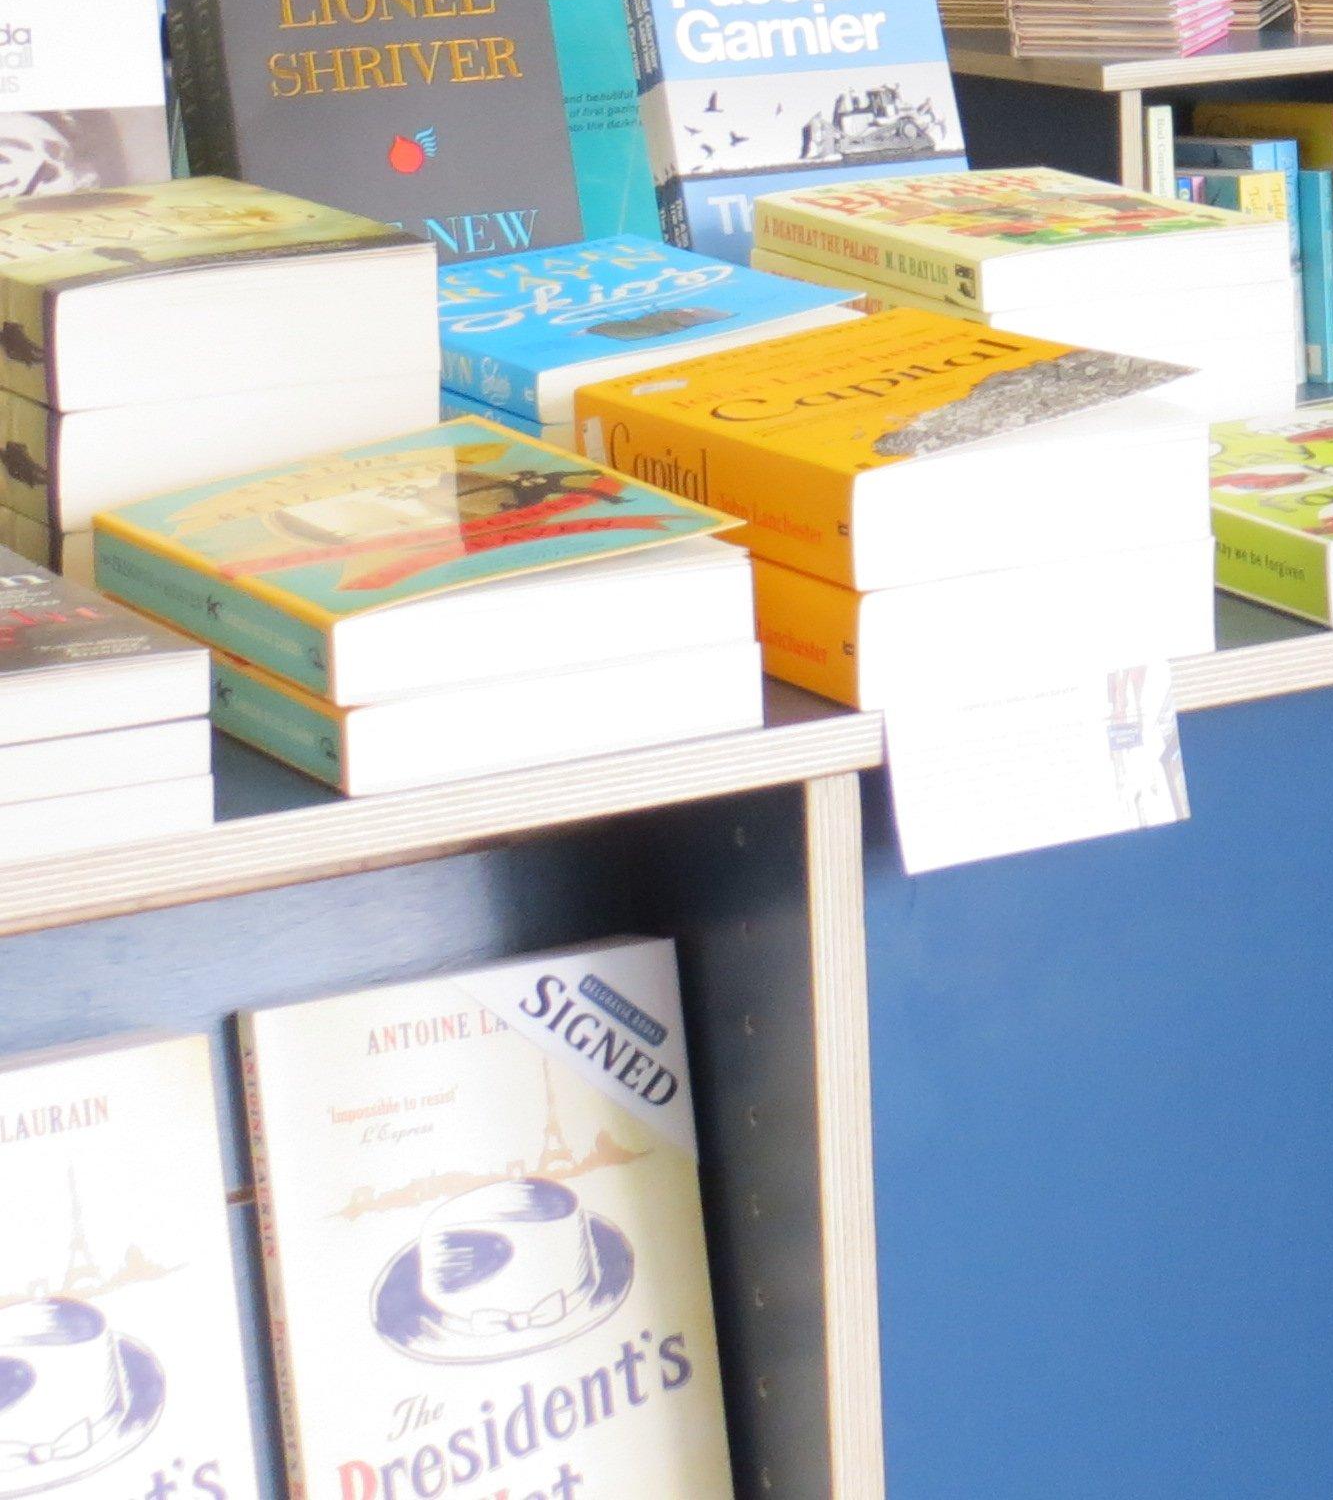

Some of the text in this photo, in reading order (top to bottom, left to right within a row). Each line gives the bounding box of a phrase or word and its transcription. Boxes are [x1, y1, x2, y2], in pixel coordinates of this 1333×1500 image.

[675, 3, 886, 67] Garnier
[267, 36, 523, 100] SHRIVER
[425, 209, 540, 255] NEW
[772, 218, 950, 287] DEATH THE PALACE BAYLIS
[710, 339, 1023, 423] Capital
[610, 421, 710, 506] Capital
[1264, 554, 1306, 582] forgiven
[366, 1009, 472, 1056] ANTOINE
[516, 971, 680, 1109] SIGNED
[336, 1329, 695, 1500] President's
[387, 1393, 447, 1443] The
